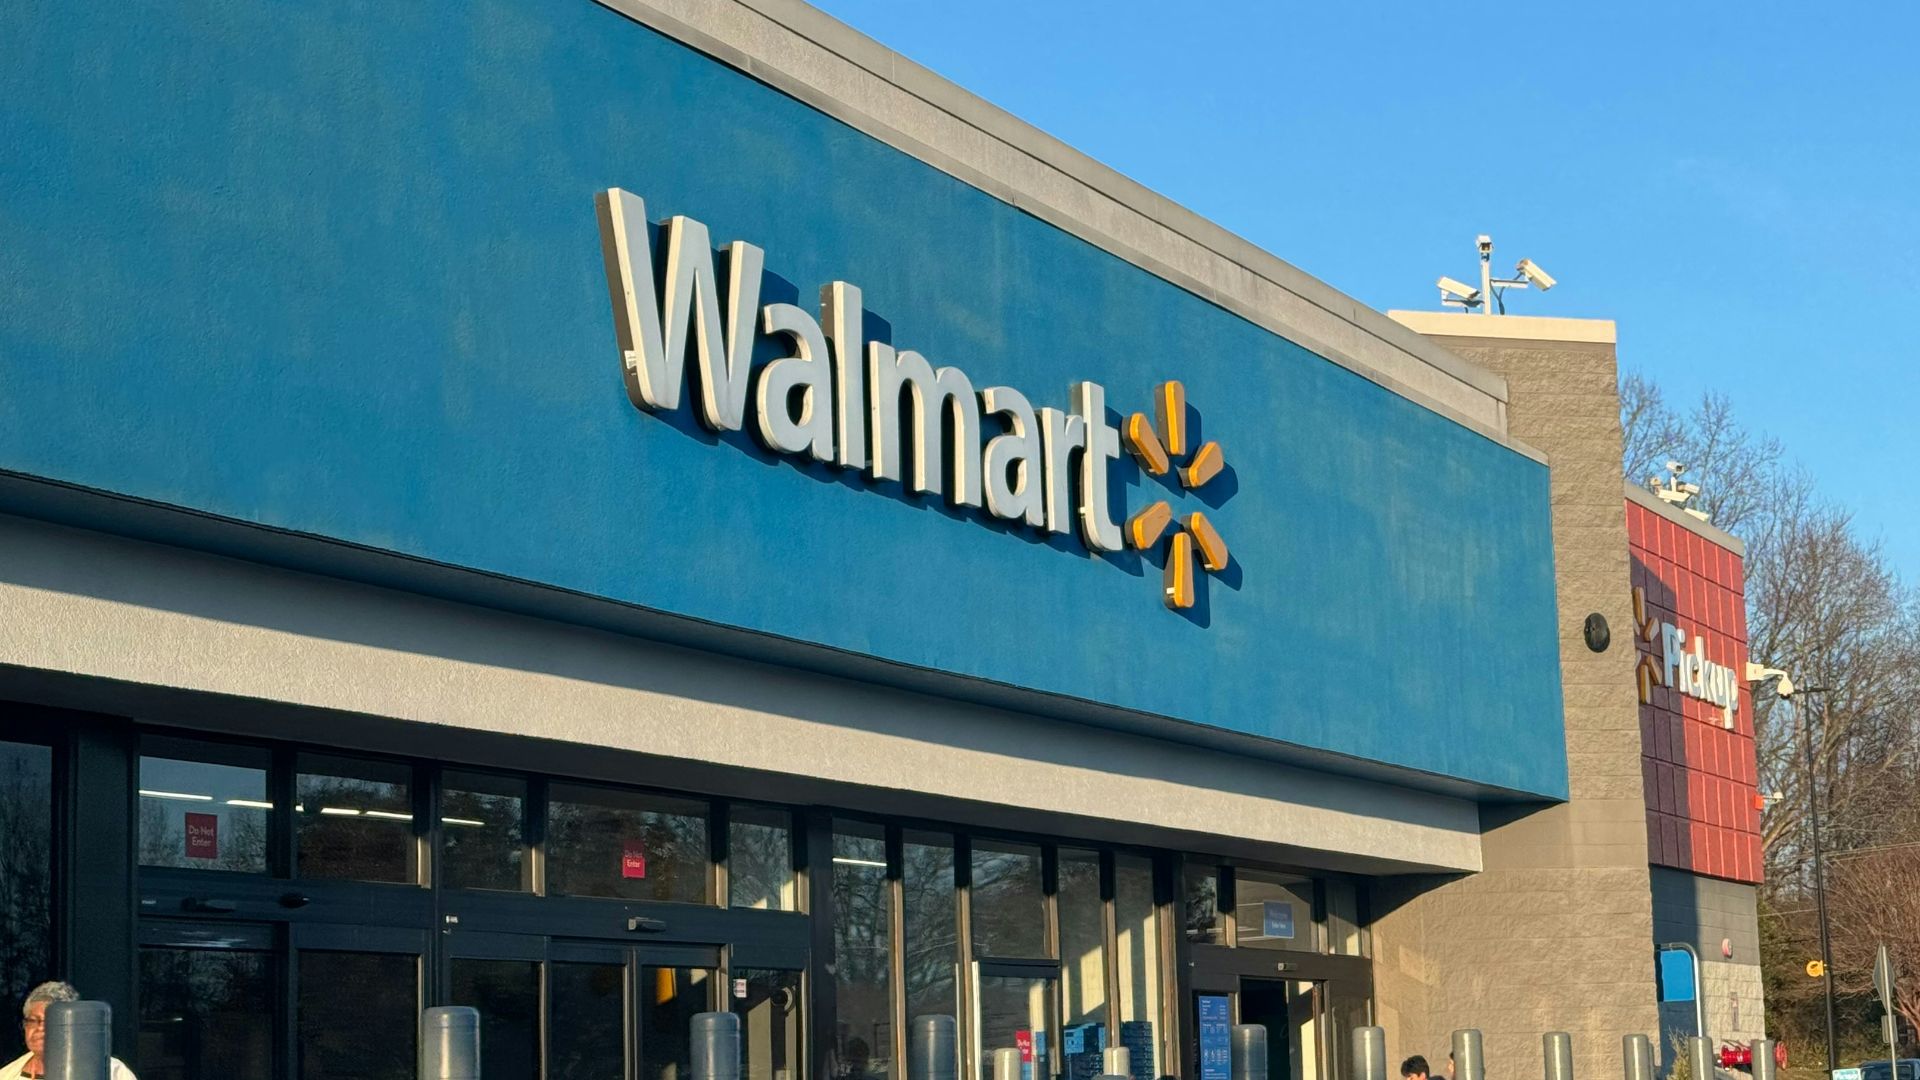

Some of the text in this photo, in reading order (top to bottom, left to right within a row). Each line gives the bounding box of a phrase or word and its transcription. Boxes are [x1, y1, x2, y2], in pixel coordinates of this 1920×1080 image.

[598, 187, 1123, 551] Walmart
[1661, 622, 1739, 729] Pickup
[188, 825, 215, 837] Do Not
[192, 836, 211, 847] Enter
